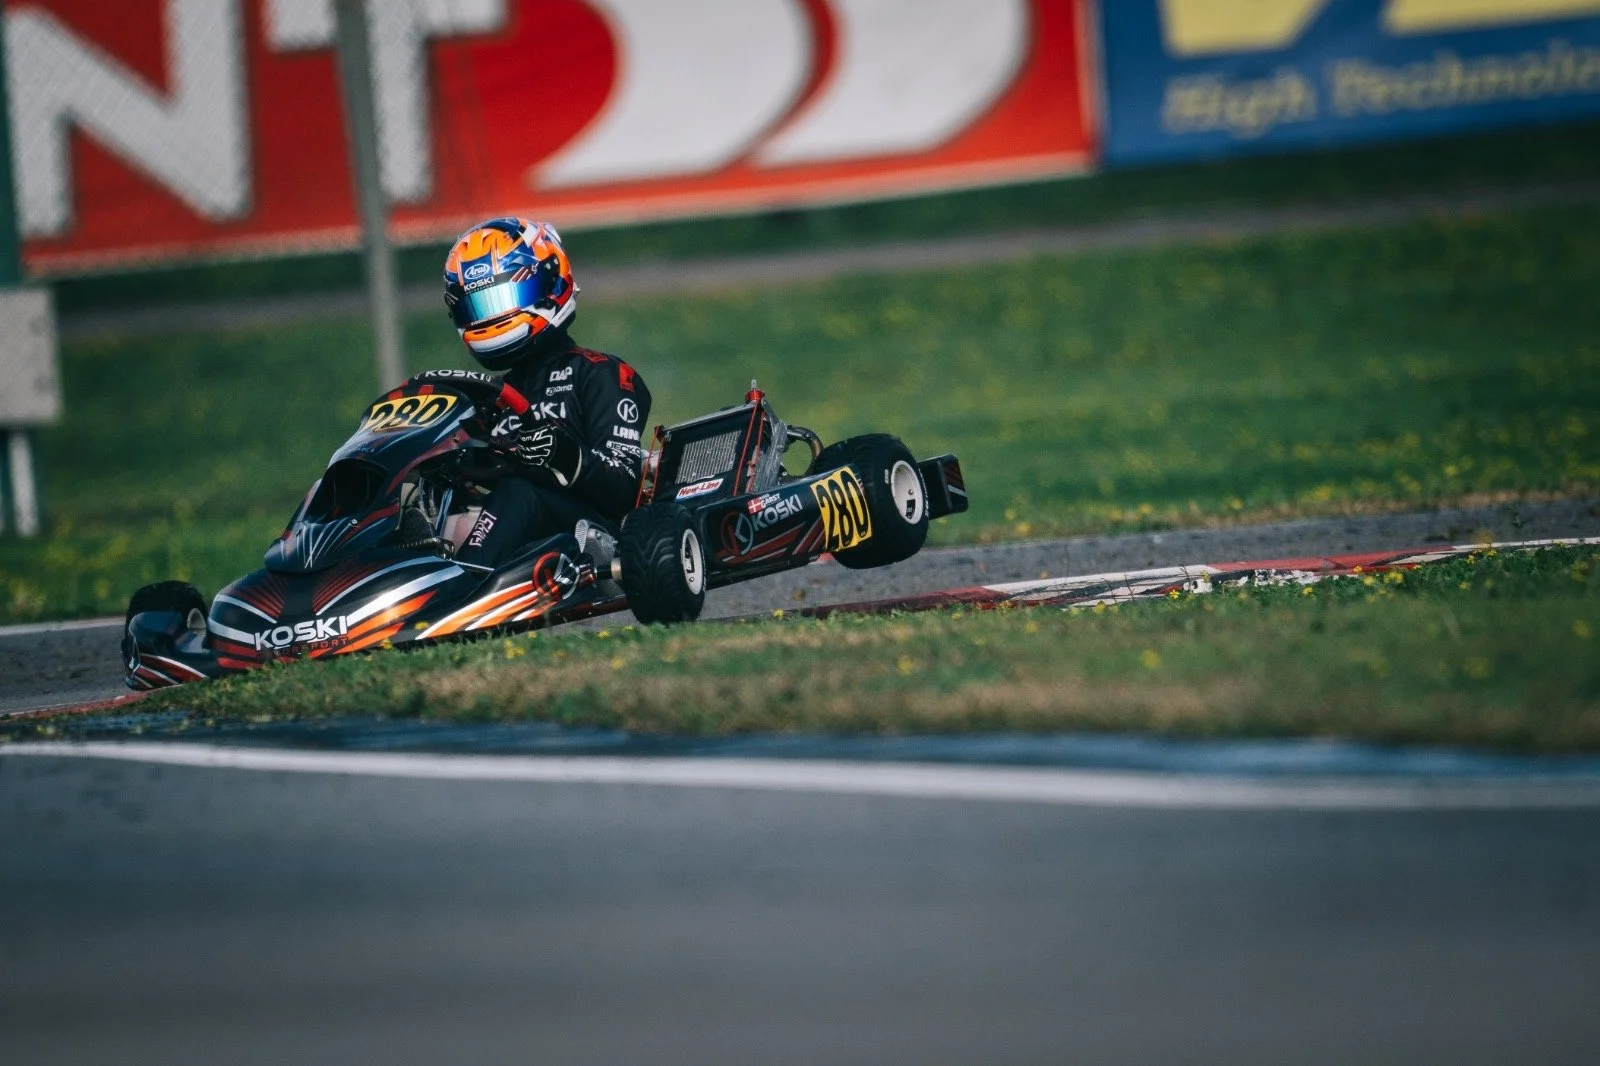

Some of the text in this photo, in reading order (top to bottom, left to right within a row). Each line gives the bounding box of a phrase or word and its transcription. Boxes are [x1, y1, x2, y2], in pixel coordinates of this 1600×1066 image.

[463, 276, 495, 292] KOSKI
[425, 369, 484, 381] KOSKI
[371, 398, 449, 429] 280
[751, 494, 803, 531] KOSKI
[815, 470, 869, 551] 280
[254, 615, 348, 651] KOSKI
